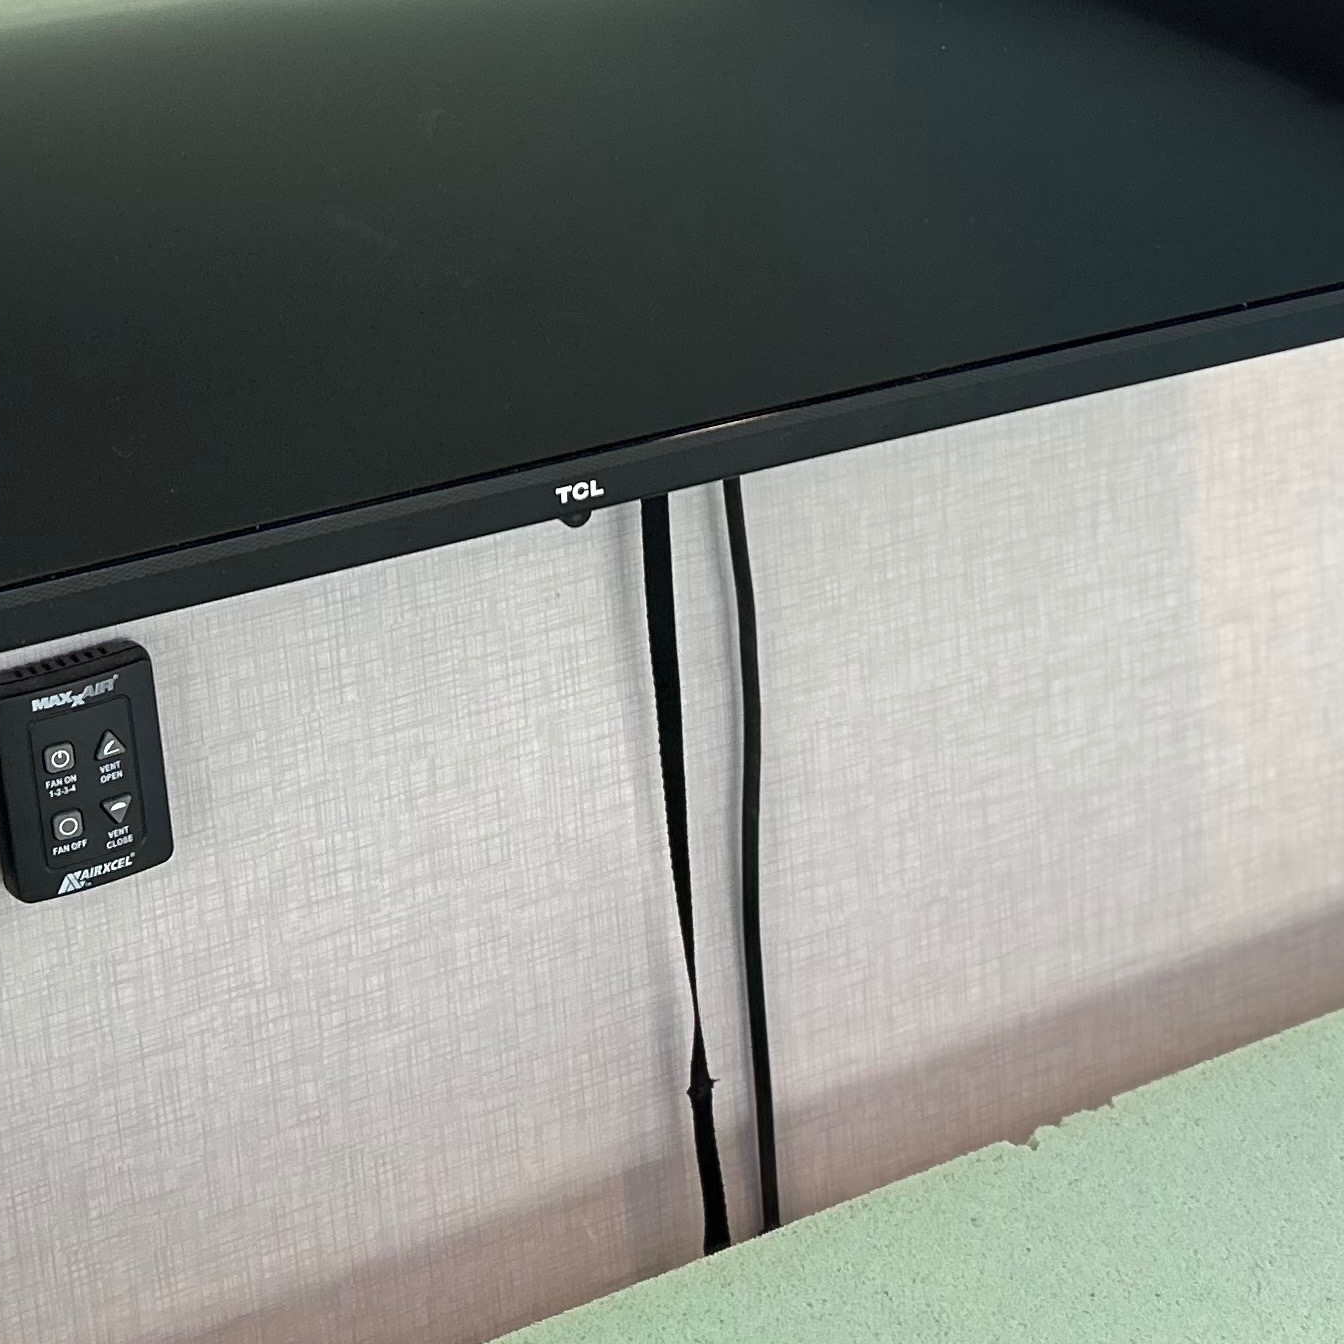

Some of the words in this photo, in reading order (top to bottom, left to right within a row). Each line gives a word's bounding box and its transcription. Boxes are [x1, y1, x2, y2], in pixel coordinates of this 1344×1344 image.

[555, 479, 605, 504] TCL
[99, 760, 121, 773] VENT
[45, 778, 63, 789] FAN
[64, 774, 77, 785] ON
[100, 770, 123, 784] OPEN
[48, 784, 76, 798] 1-2-3-4
[107, 825, 130, 838] VENT
[52, 844, 70, 856] FAN
[71, 838, 88, 851] OFF
[106, 834, 134, 850] CLOSE
[80, 855, 133, 880] AIRXCEL
